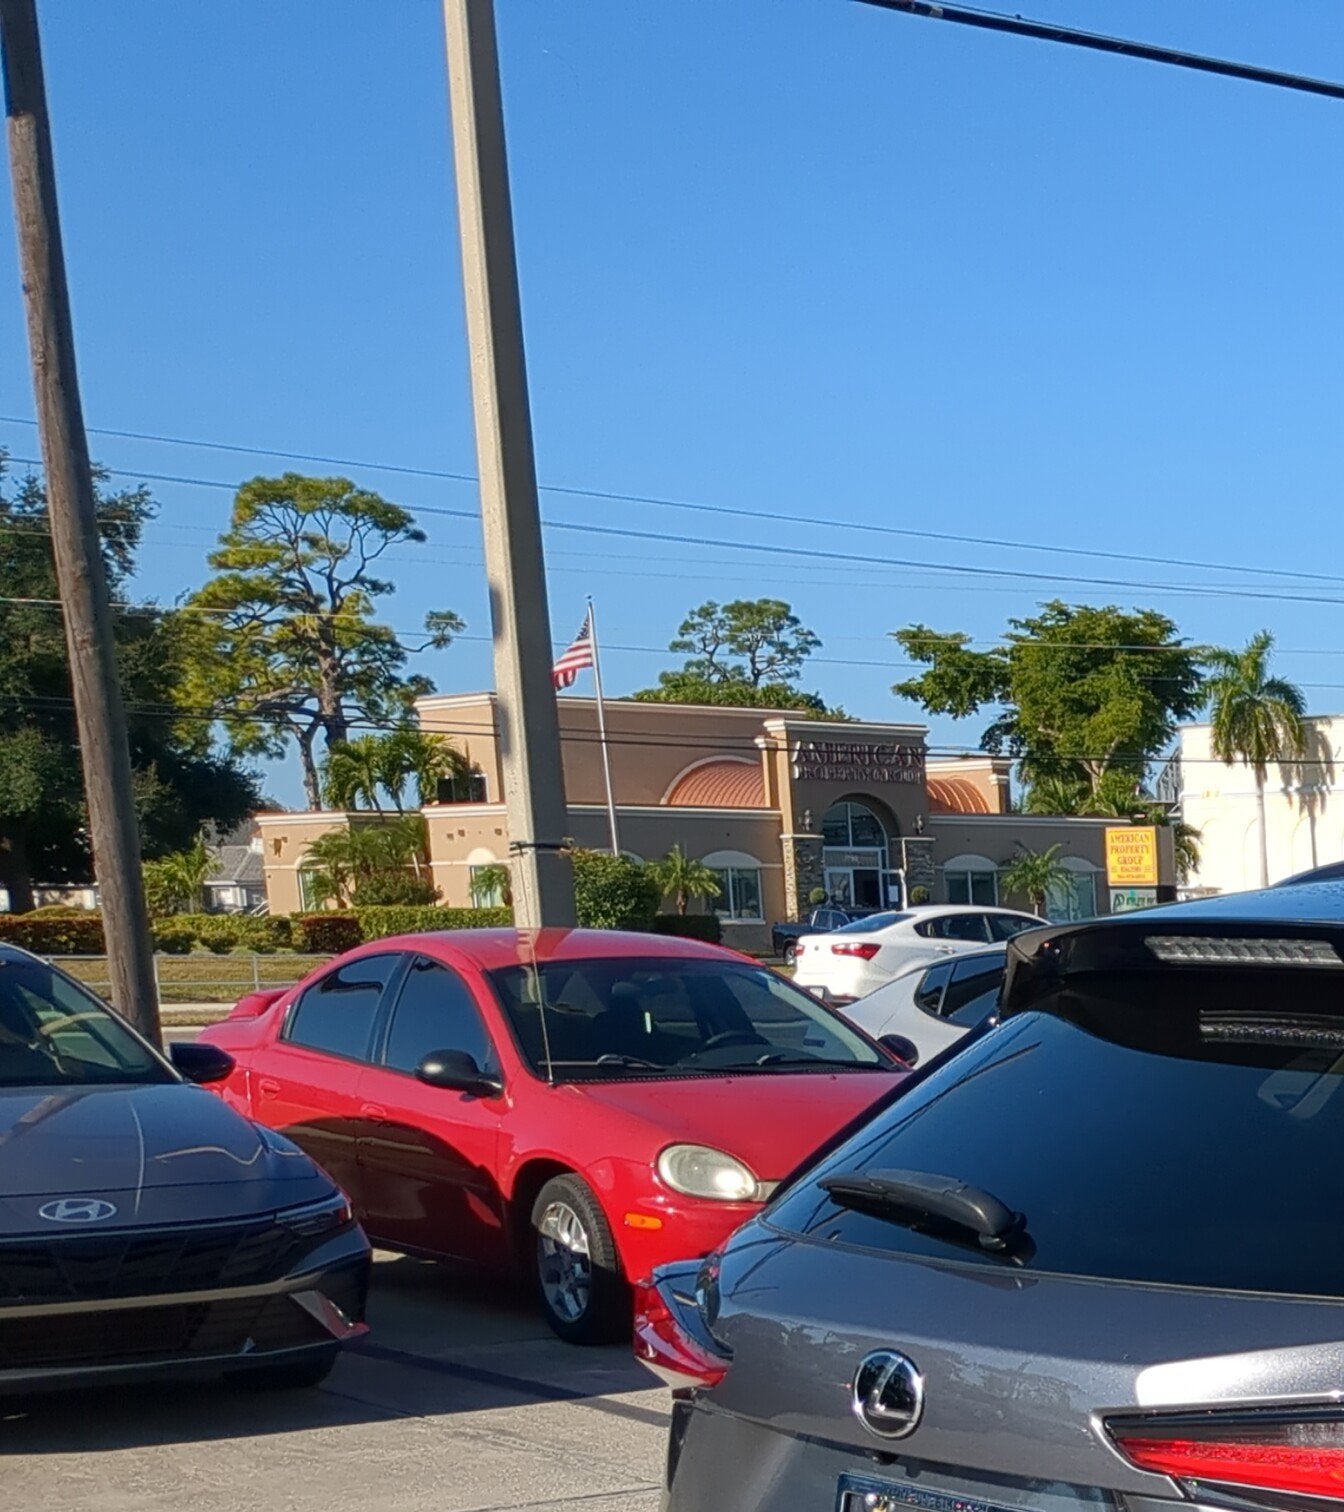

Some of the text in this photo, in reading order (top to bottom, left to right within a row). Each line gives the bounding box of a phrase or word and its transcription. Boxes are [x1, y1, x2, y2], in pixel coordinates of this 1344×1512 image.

[791, 740, 923, 768] AMERICAN
[1110, 833, 1150, 844] AMERICAN
[1110, 845, 1150, 855] PROPERTY
